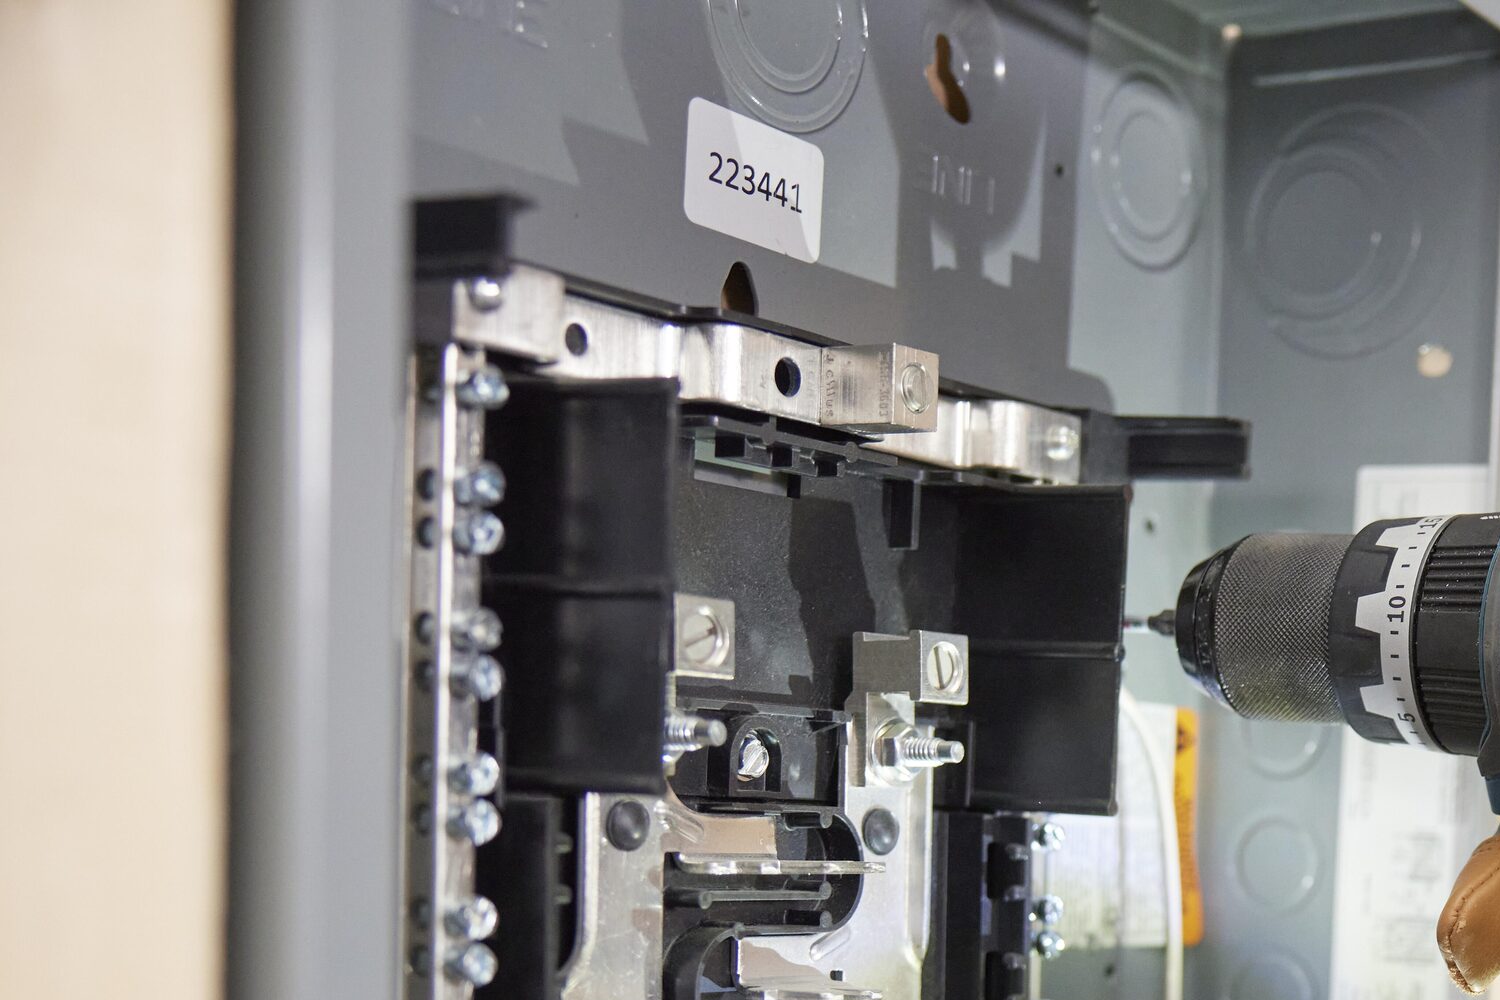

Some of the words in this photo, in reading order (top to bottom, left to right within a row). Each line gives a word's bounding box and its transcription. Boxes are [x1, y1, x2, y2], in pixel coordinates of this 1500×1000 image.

[708, 151, 803, 214] 223441
[1387, 595, 1407, 623] 10
[1397, 712, 1416, 723] 5
